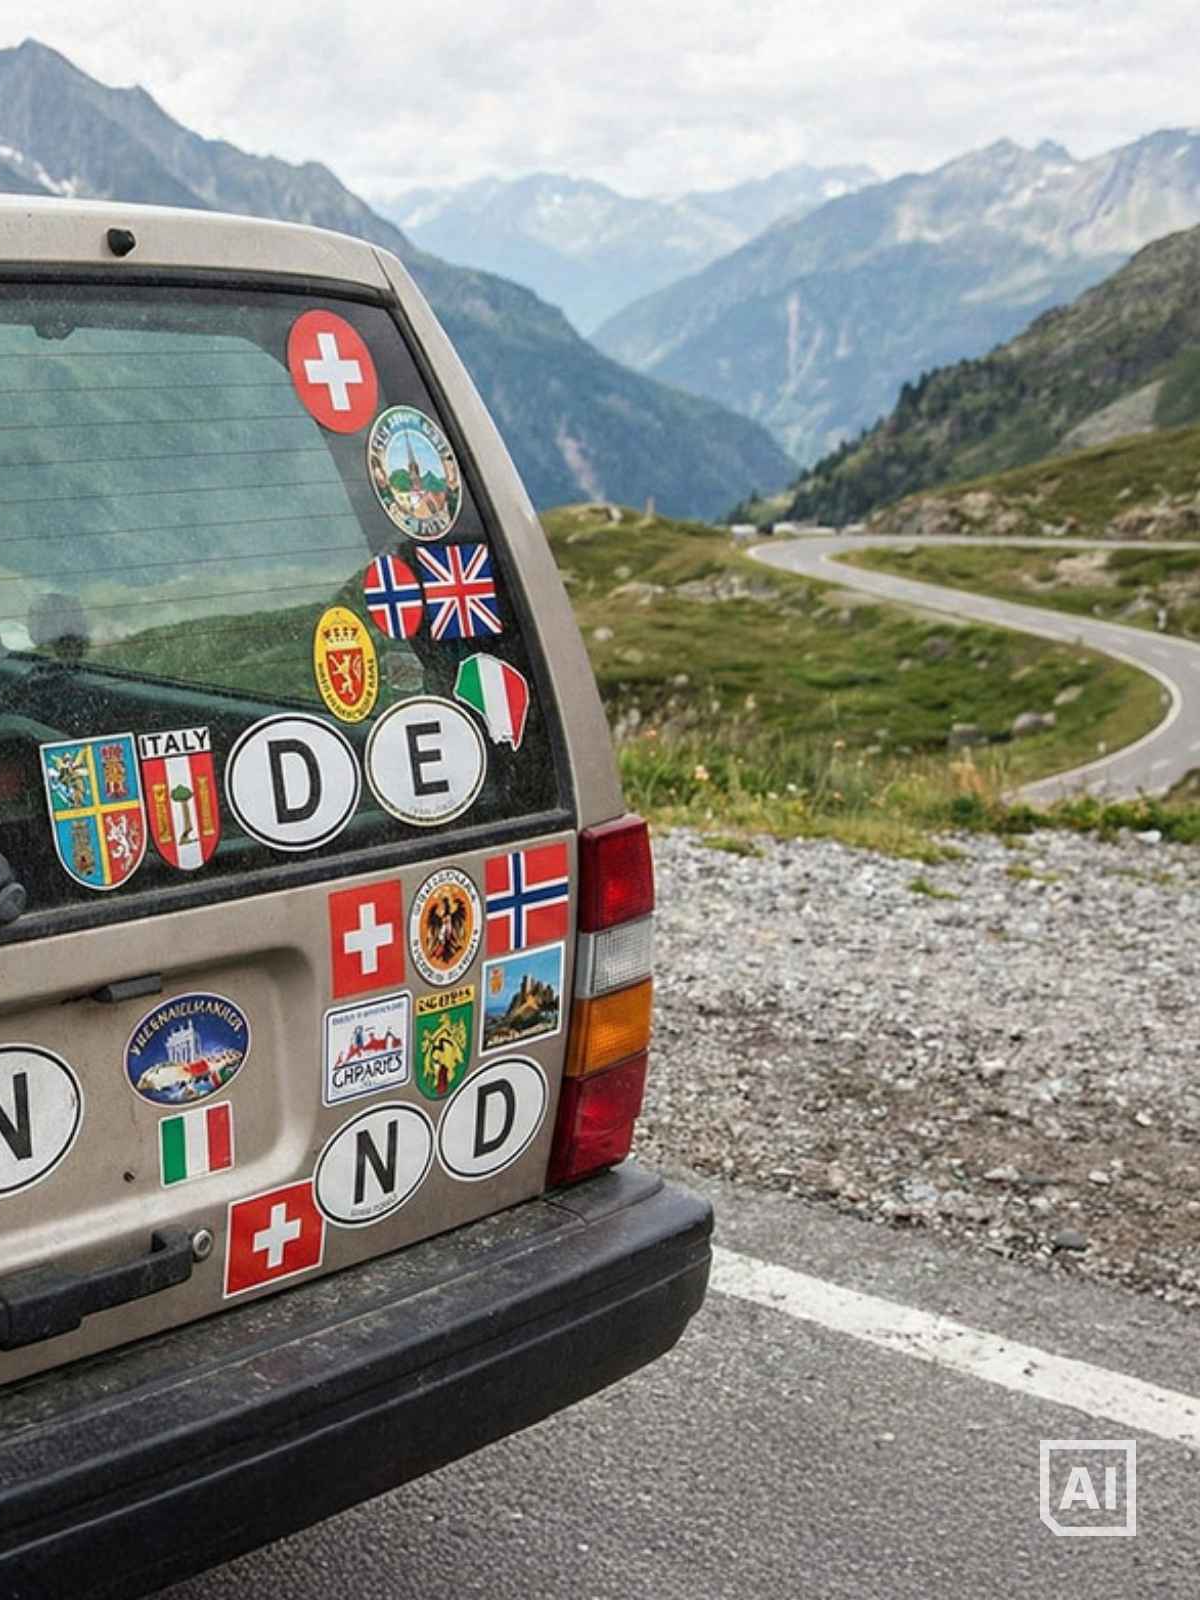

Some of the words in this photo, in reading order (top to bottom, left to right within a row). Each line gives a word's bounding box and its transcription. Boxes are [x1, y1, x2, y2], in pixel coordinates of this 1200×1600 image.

[141, 729, 208, 756] ITALY
[267, 738, 322, 824] D
[405, 721, 450, 797] E
[473, 1077, 516, 1158] D
[354, 1118, 399, 1205] N
